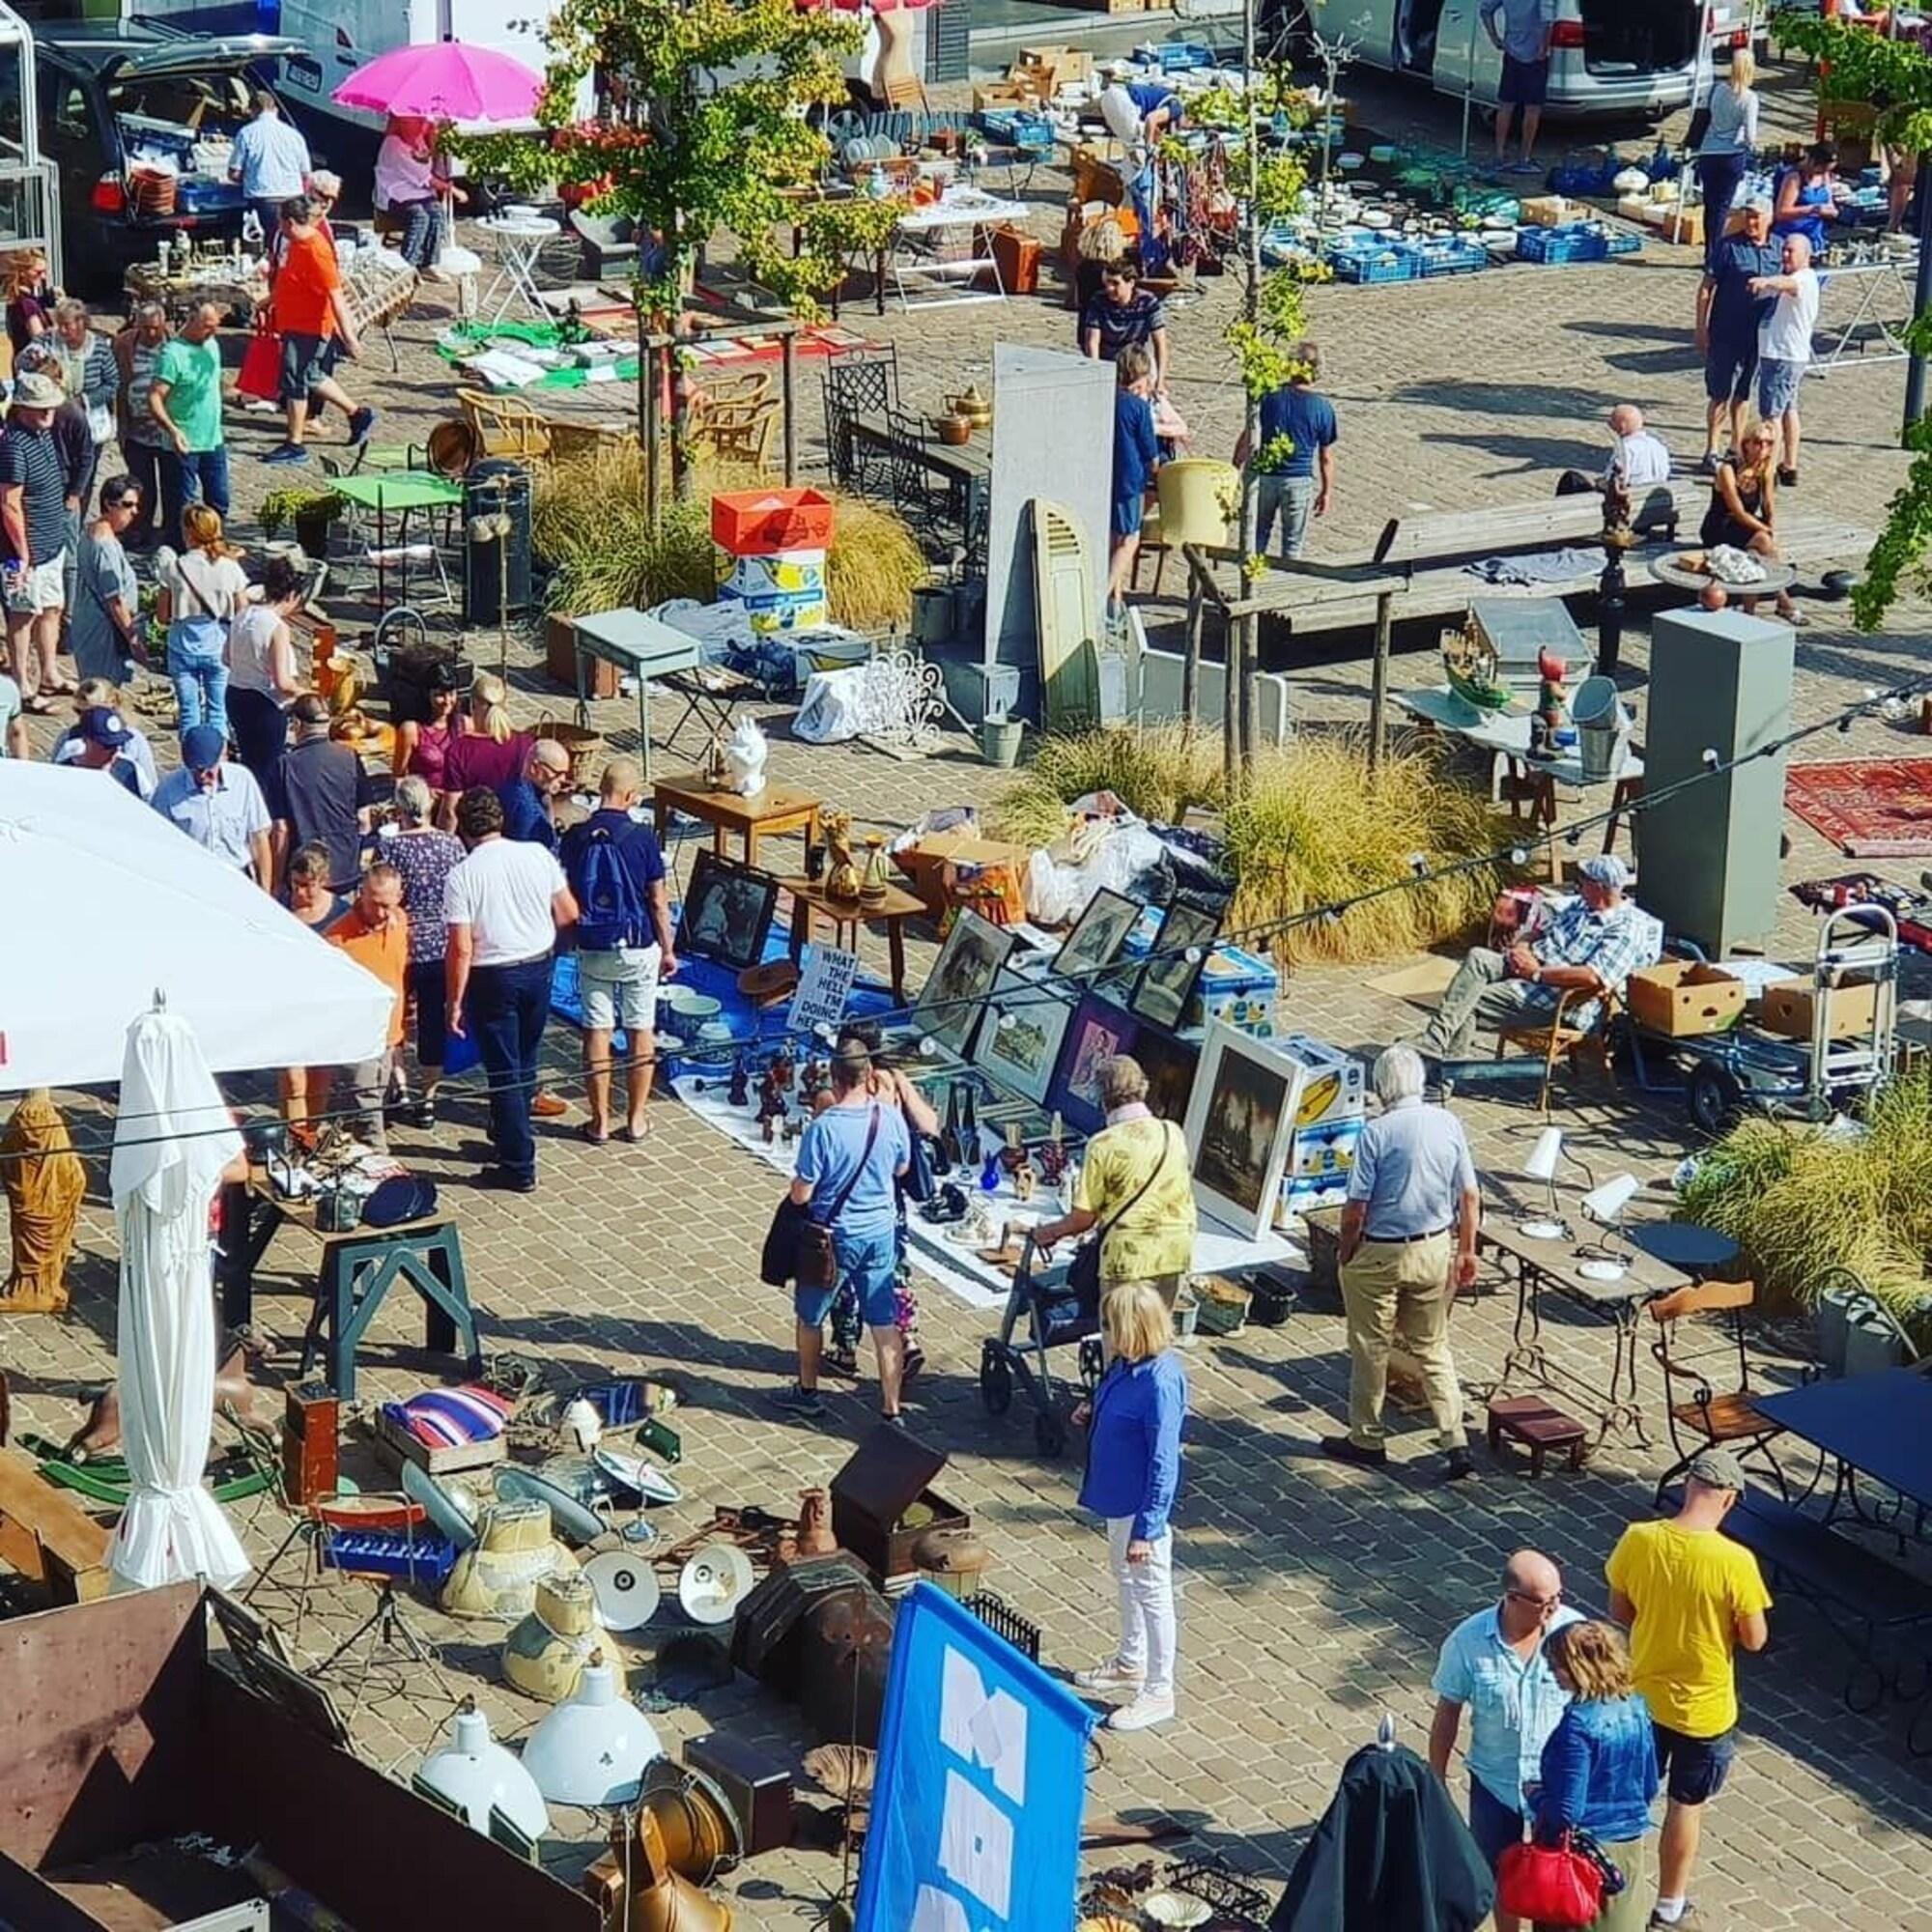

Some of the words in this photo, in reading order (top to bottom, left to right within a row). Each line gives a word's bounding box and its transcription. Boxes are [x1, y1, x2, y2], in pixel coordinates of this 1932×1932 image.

[823, 950, 855, 968] WHAT
[829, 966, 850, 983] THE
[817, 977, 844, 995] HELL
[801, 1001, 838, 1020] DOING
